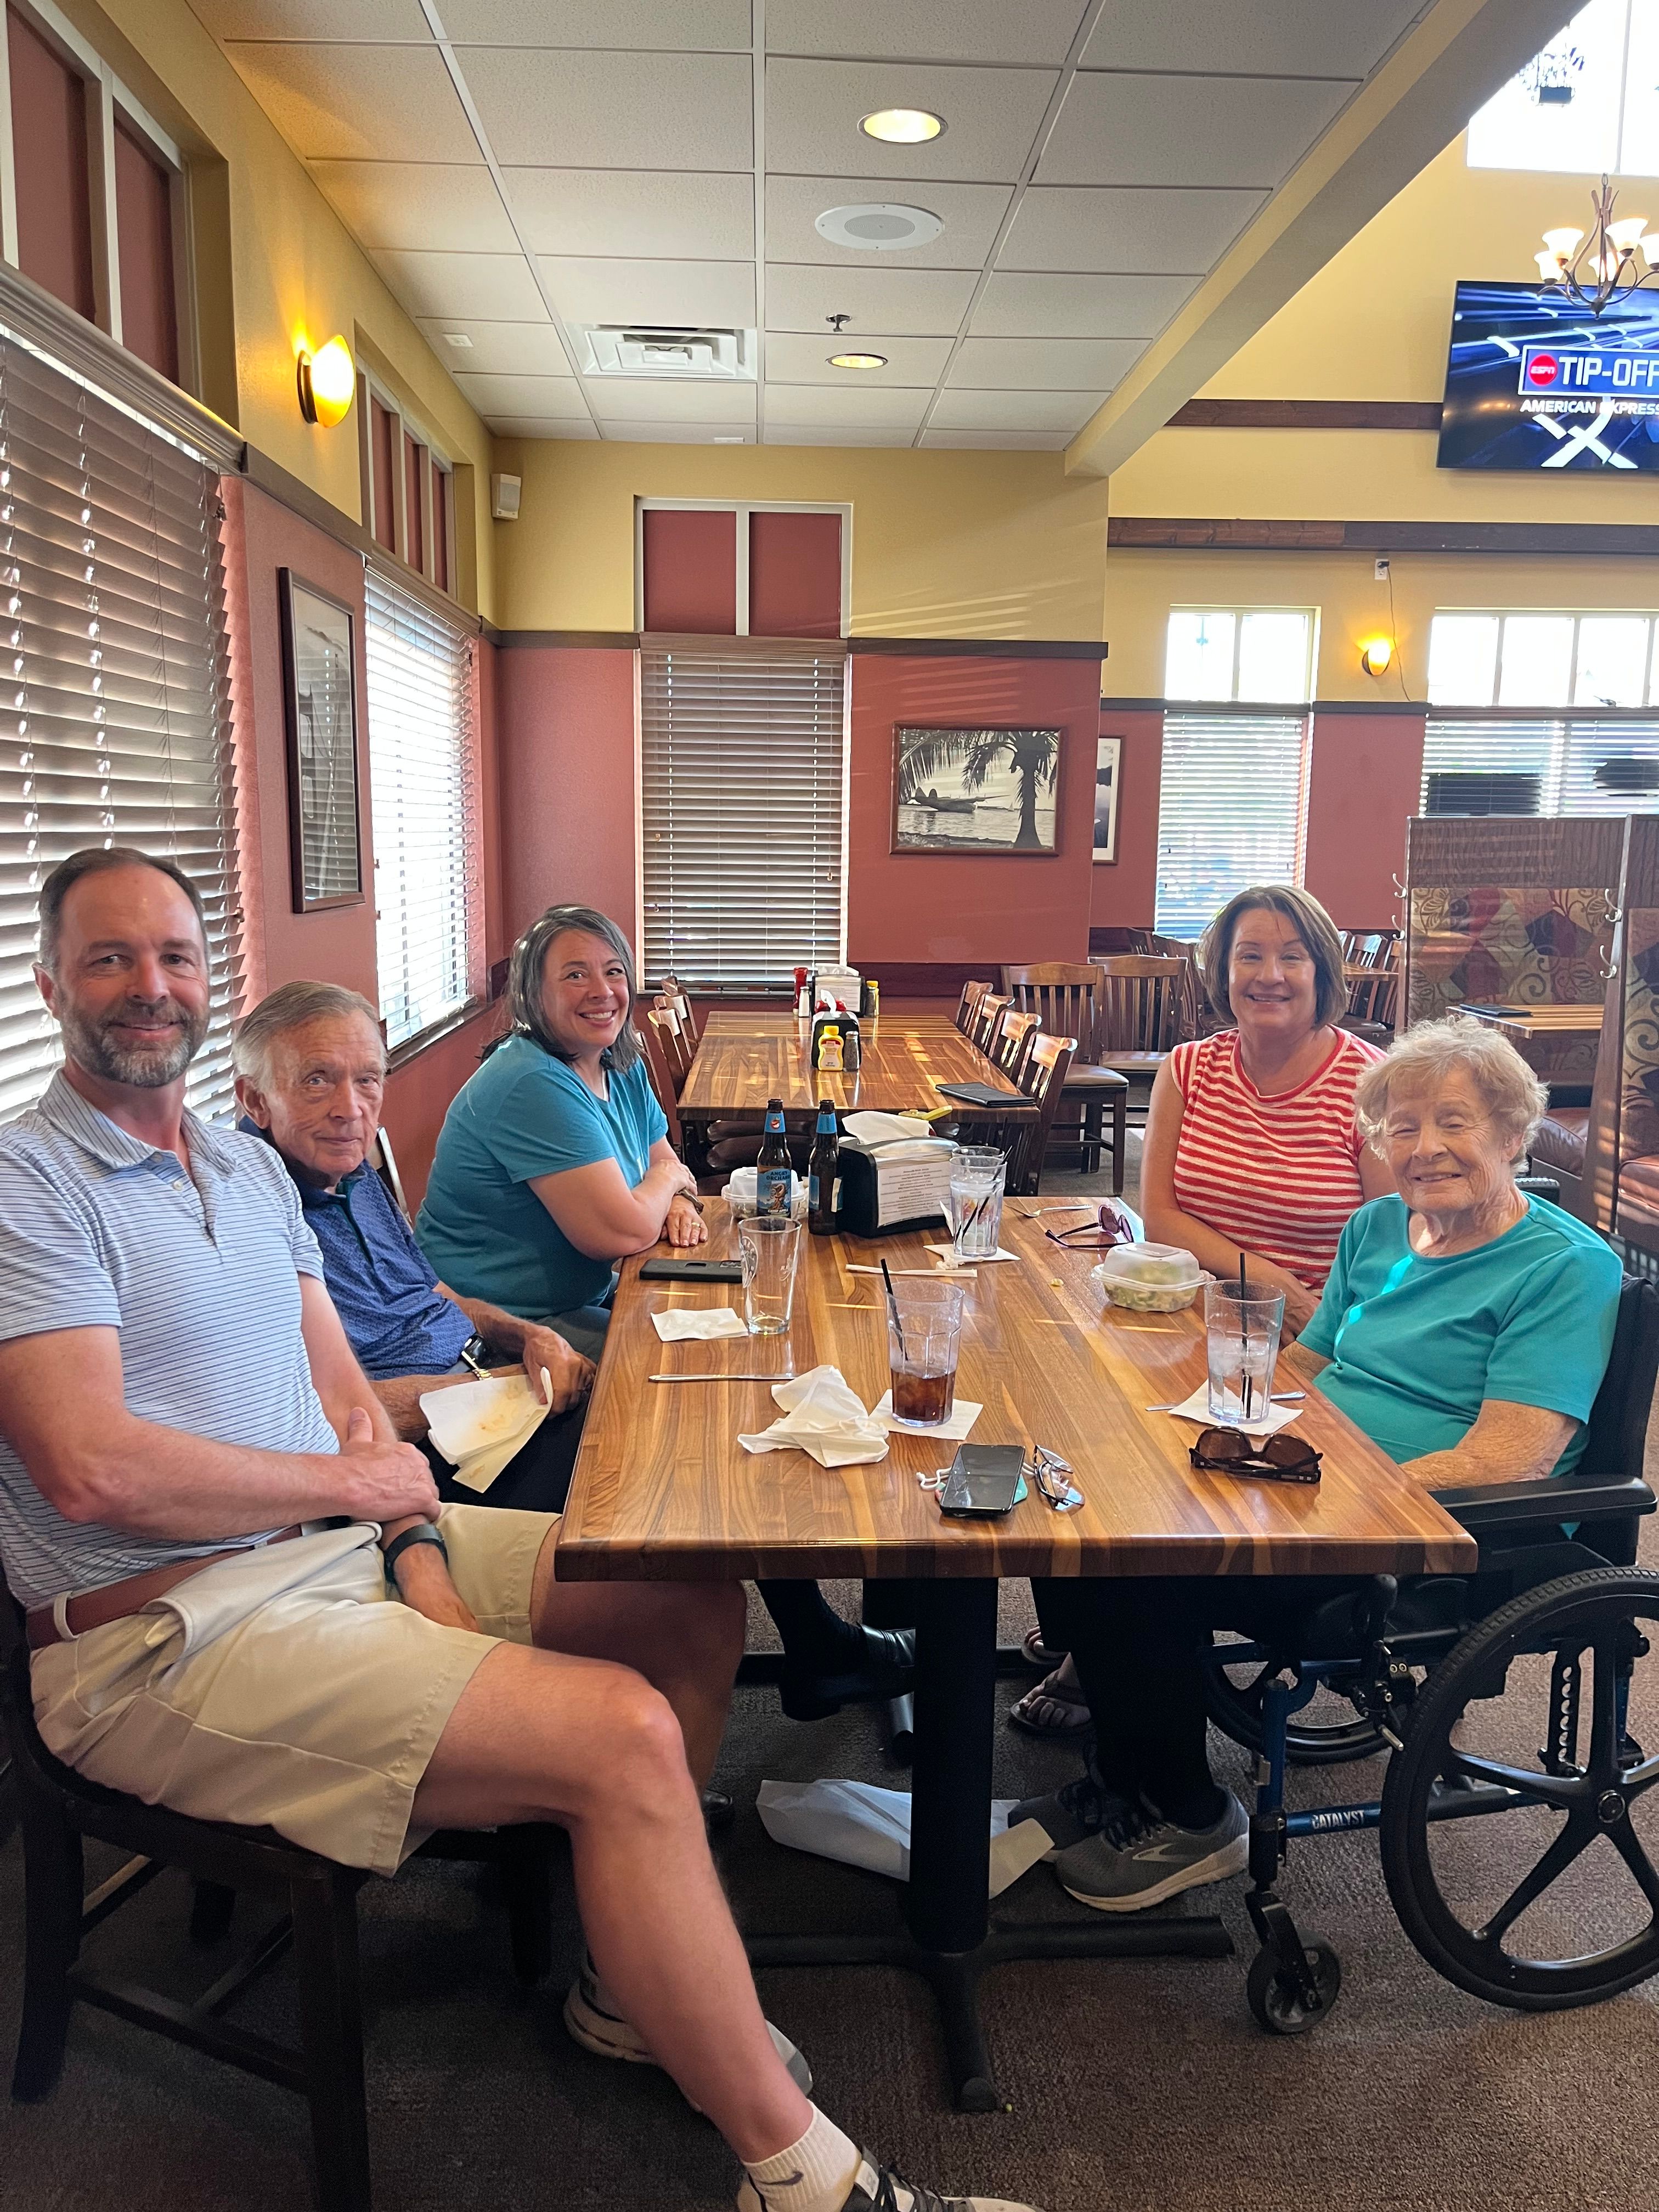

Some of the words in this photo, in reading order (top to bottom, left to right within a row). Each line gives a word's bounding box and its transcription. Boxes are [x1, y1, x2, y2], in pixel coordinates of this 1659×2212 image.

[1530, 365, 1555, 375] ESPN
[1559, 356, 1659, 387] TIP-OFF
[1520, 399, 1596, 414] AMERICAN
[1312, 1810, 1364, 1830] CATALYST
